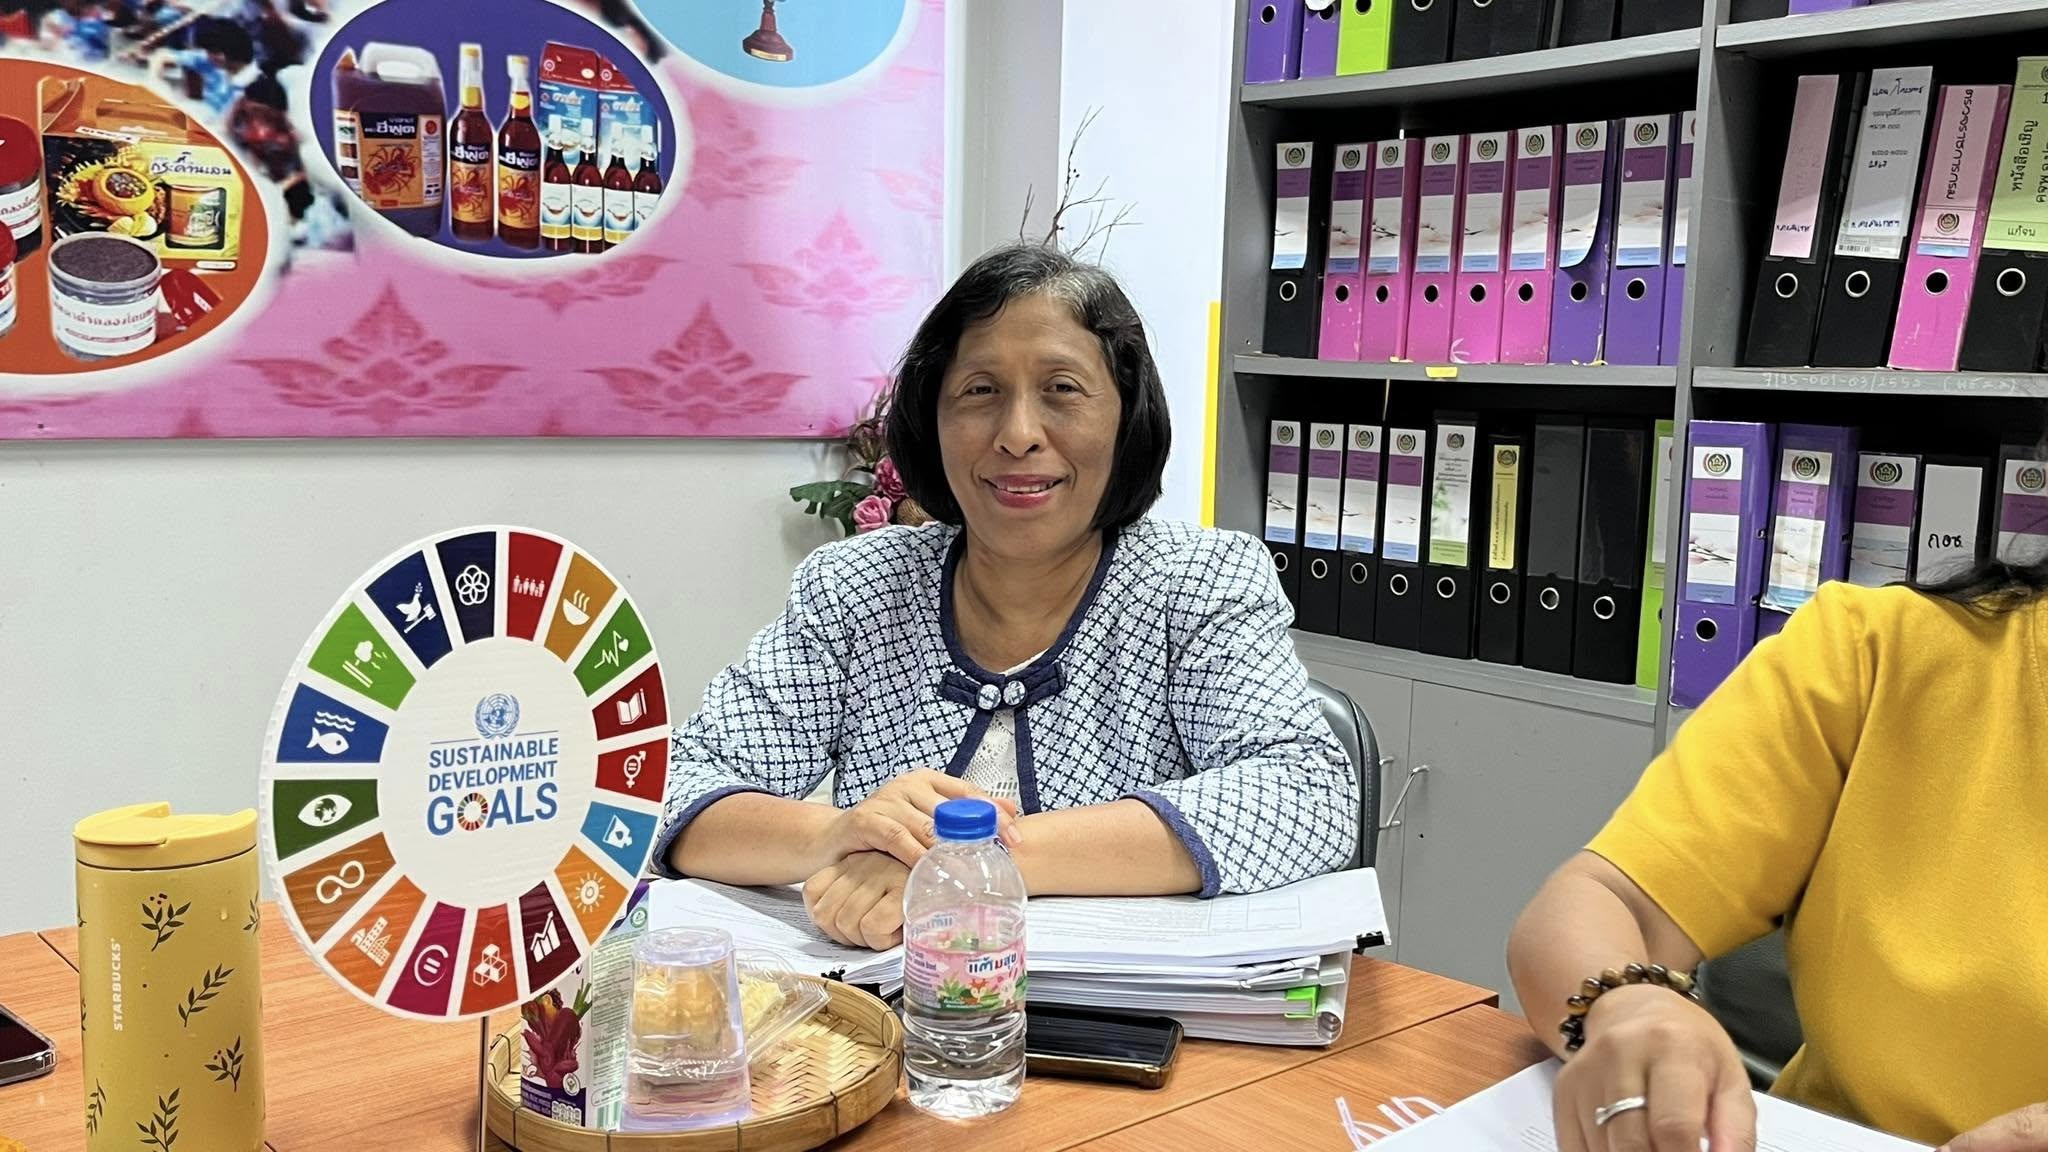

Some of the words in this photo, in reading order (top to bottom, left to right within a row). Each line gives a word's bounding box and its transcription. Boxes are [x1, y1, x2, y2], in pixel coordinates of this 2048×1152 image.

[1946, 89, 1974, 200] ตรวจราชการกรม
[2010, 120, 2039, 191] หนังสือเชิญ
[429, 737, 559, 768] SUSTAINABLE
[429, 760, 558, 792] DEVELOPMENT
[427, 782, 558, 836] GOALS
[112, 942, 123, 1031] STARBUCKS
[968, 953, 1017, 973] แต้มสุข
